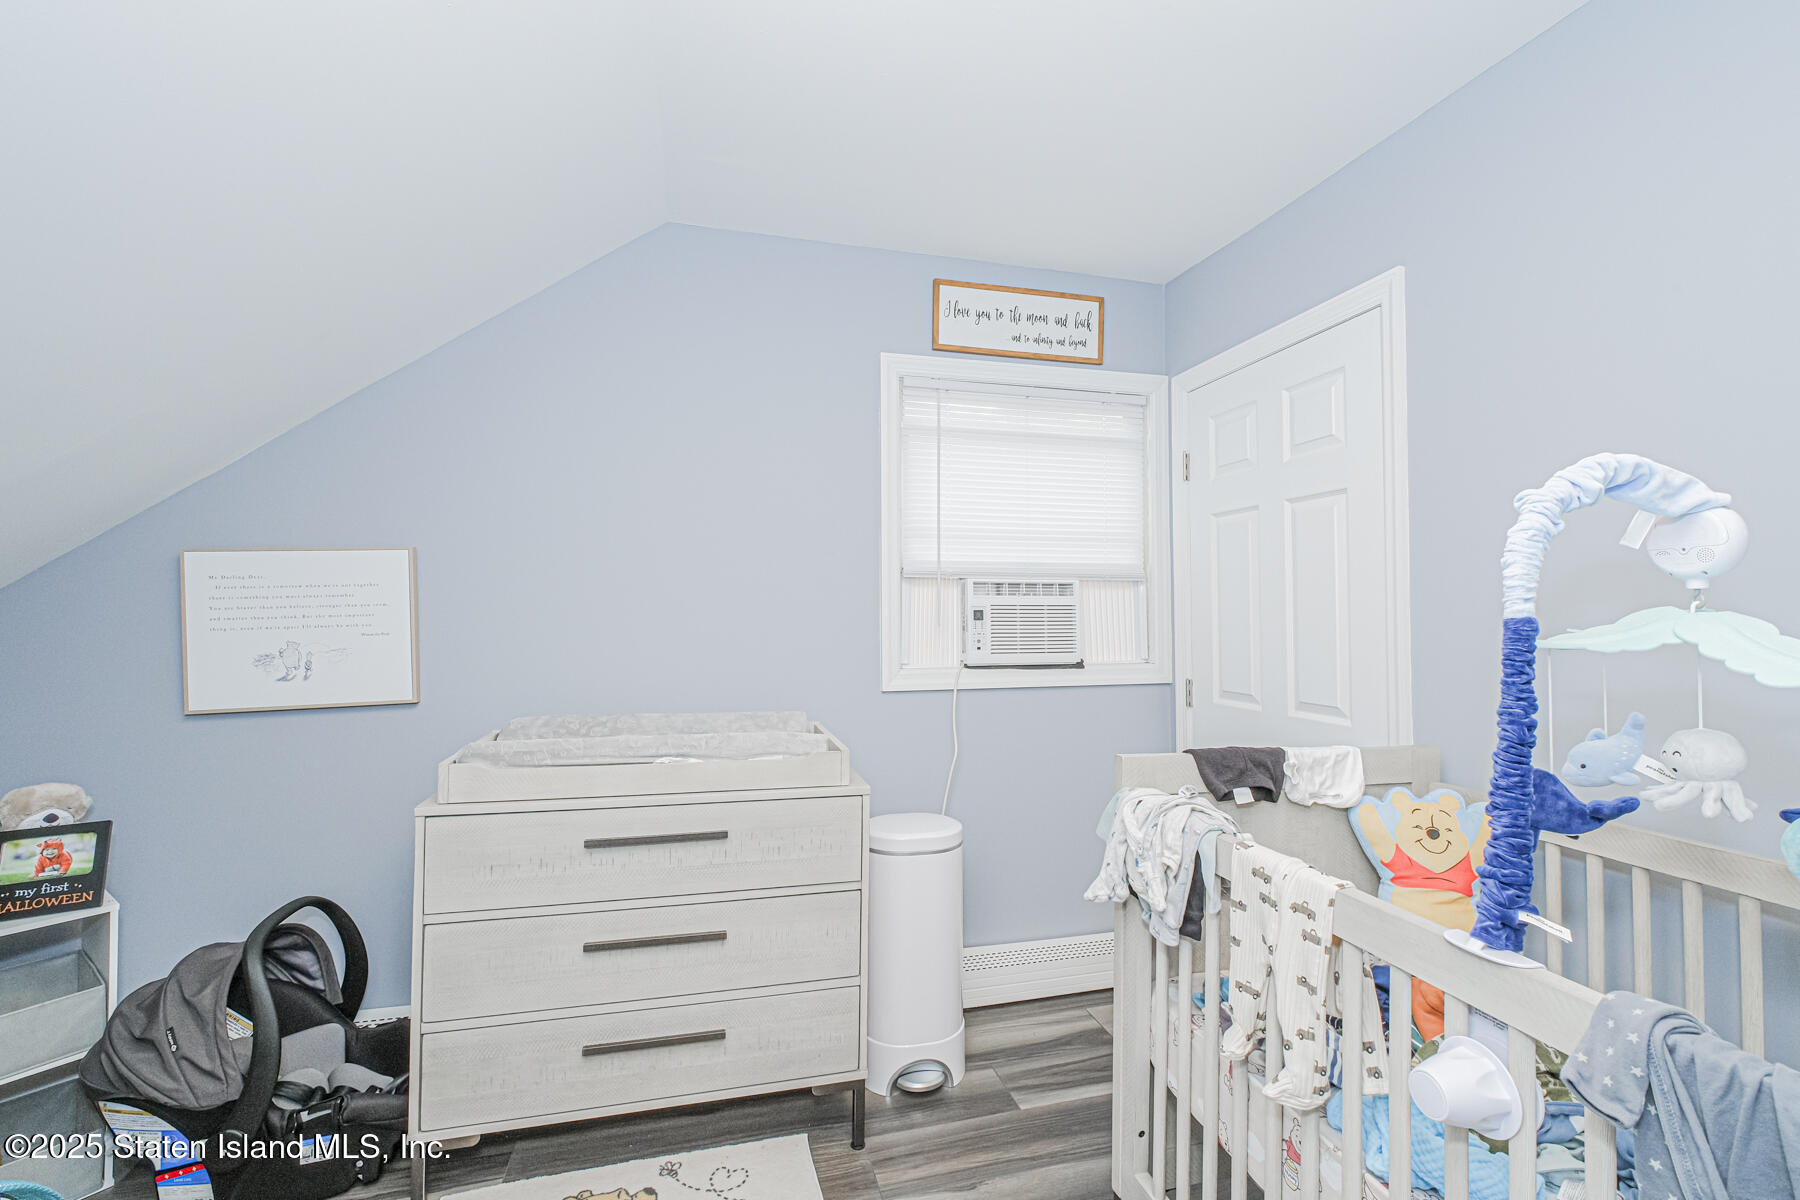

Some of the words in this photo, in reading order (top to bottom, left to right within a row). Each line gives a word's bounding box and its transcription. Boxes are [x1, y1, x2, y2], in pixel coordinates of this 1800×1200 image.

[944, 300, 952, 318] I
[954, 300, 971, 319] love
[976, 308, 992, 326] you
[996, 308, 1004, 320] to
[1009, 306, 1022, 325] the
[1026, 312, 1048, 326] moon
[1054, 314, 1068, 328] and
[1074, 310, 1092, 332] back
[1024, 334, 1030, 344] to
[1032, 332, 1053, 348] infinity
[1068, 334, 1088, 350] beyond
[14, 888, 37, 898] my
[40, 882, 70, 894] first
